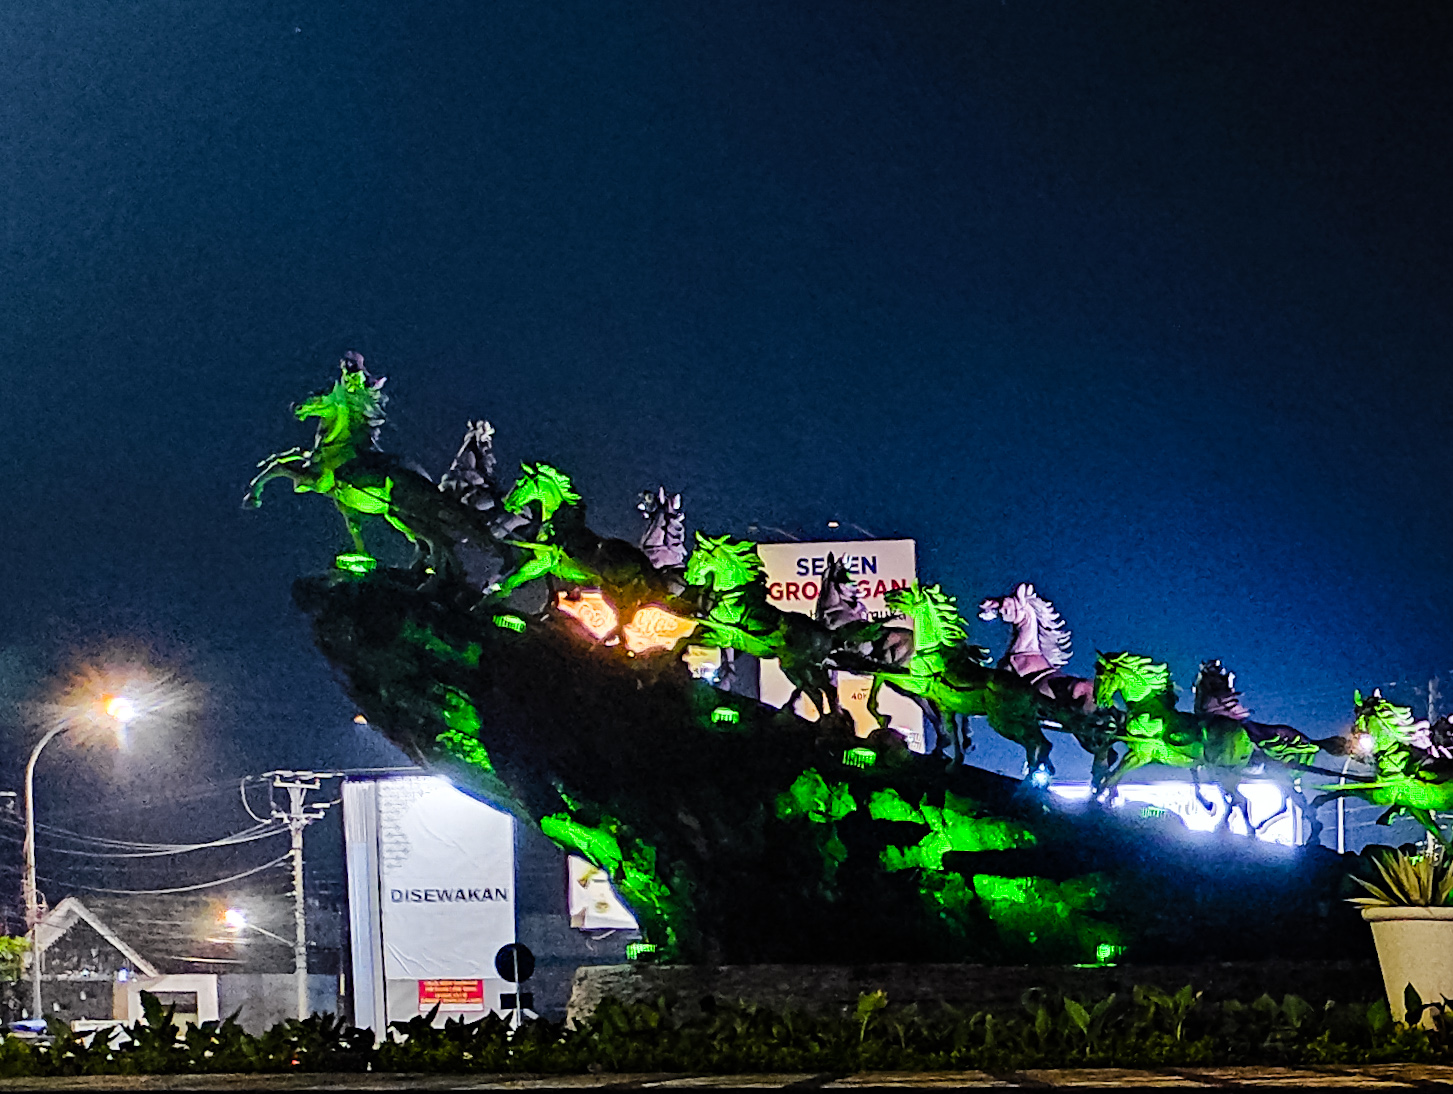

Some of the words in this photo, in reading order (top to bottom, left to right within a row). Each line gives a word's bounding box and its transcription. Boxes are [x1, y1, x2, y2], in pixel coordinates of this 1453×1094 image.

[796, 555, 878, 576] SEEN
[768, 578, 907, 601] GROGAN
[390, 888, 508, 902] DISEWAKAN
